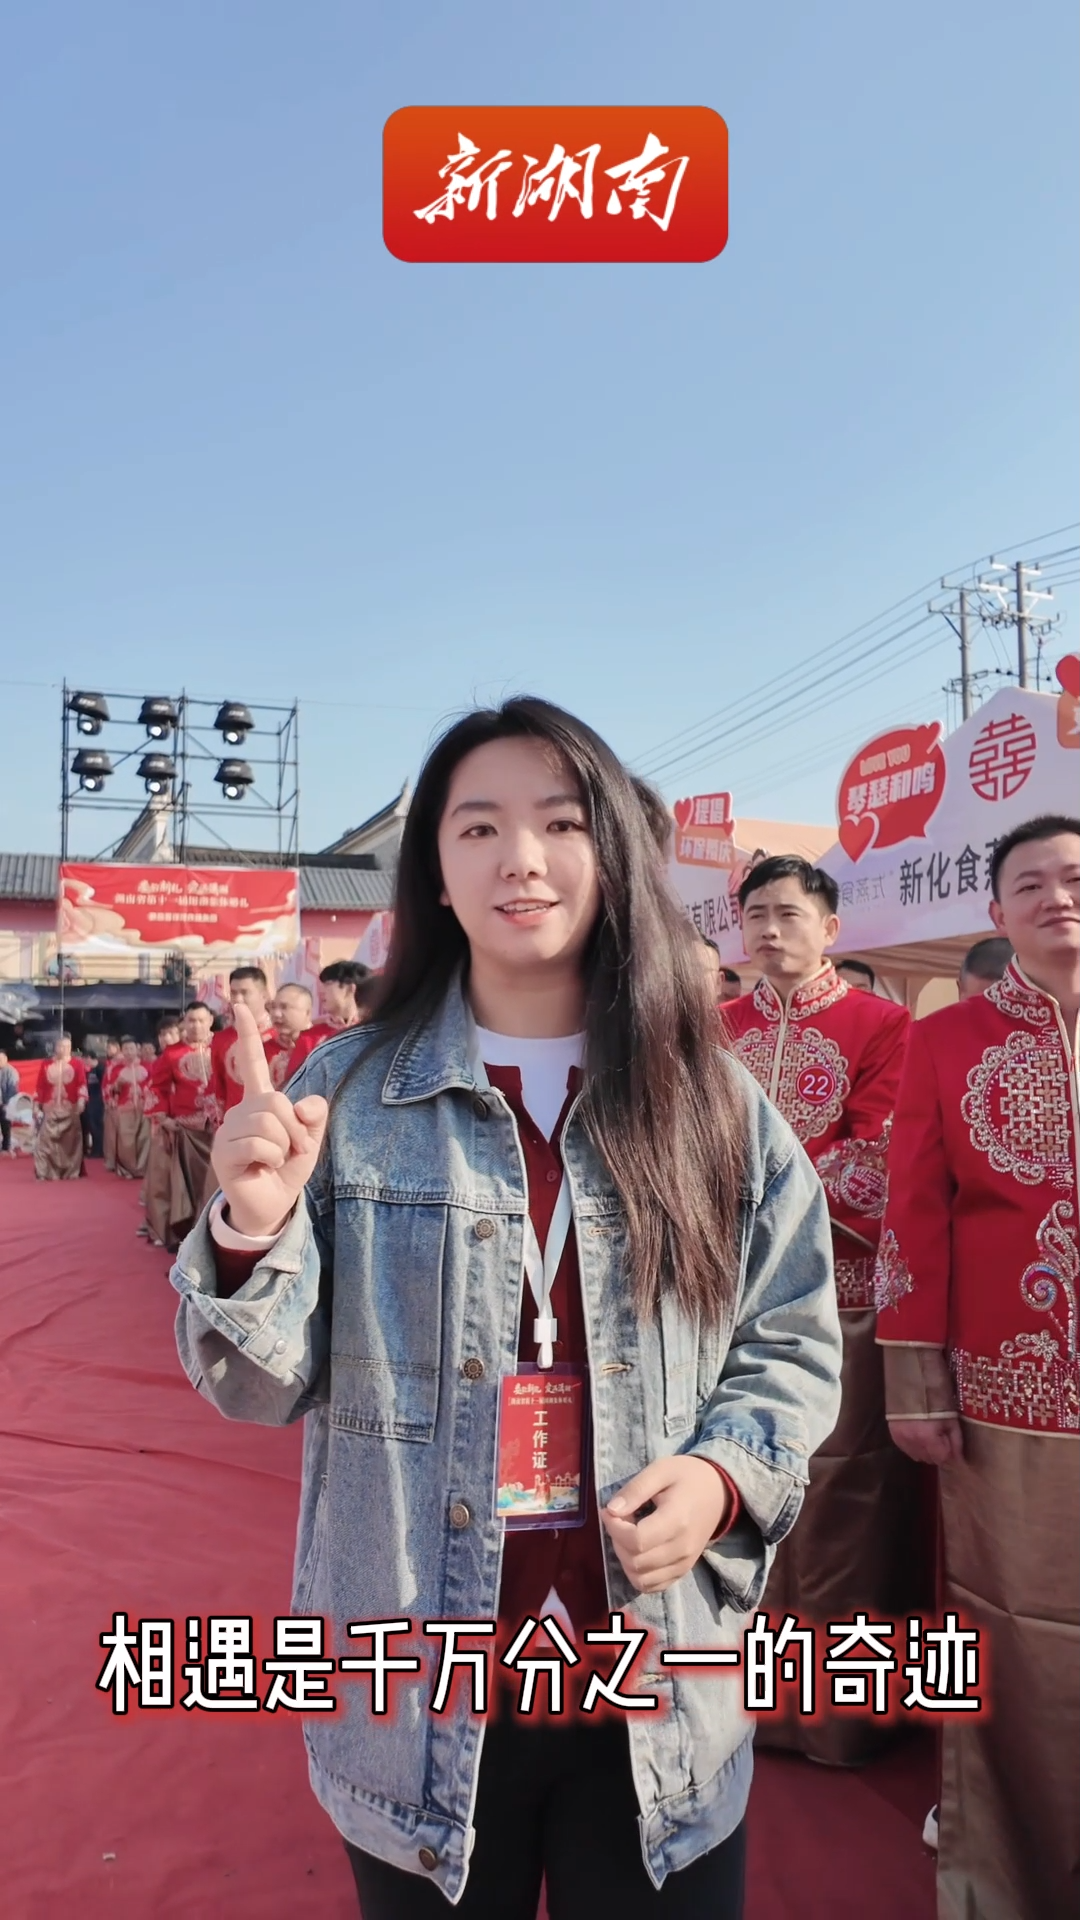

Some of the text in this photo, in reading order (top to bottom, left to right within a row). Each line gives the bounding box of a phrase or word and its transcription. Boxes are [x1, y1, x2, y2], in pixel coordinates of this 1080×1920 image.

[848, 762, 935, 814] 琴瑟和鸣
[695, 798, 724, 825] 提倡
[686, 893, 743, 937] 有限公司
[802, 1074, 828, 1097] 22
[532, 1411, 548, 1469] 工作证
